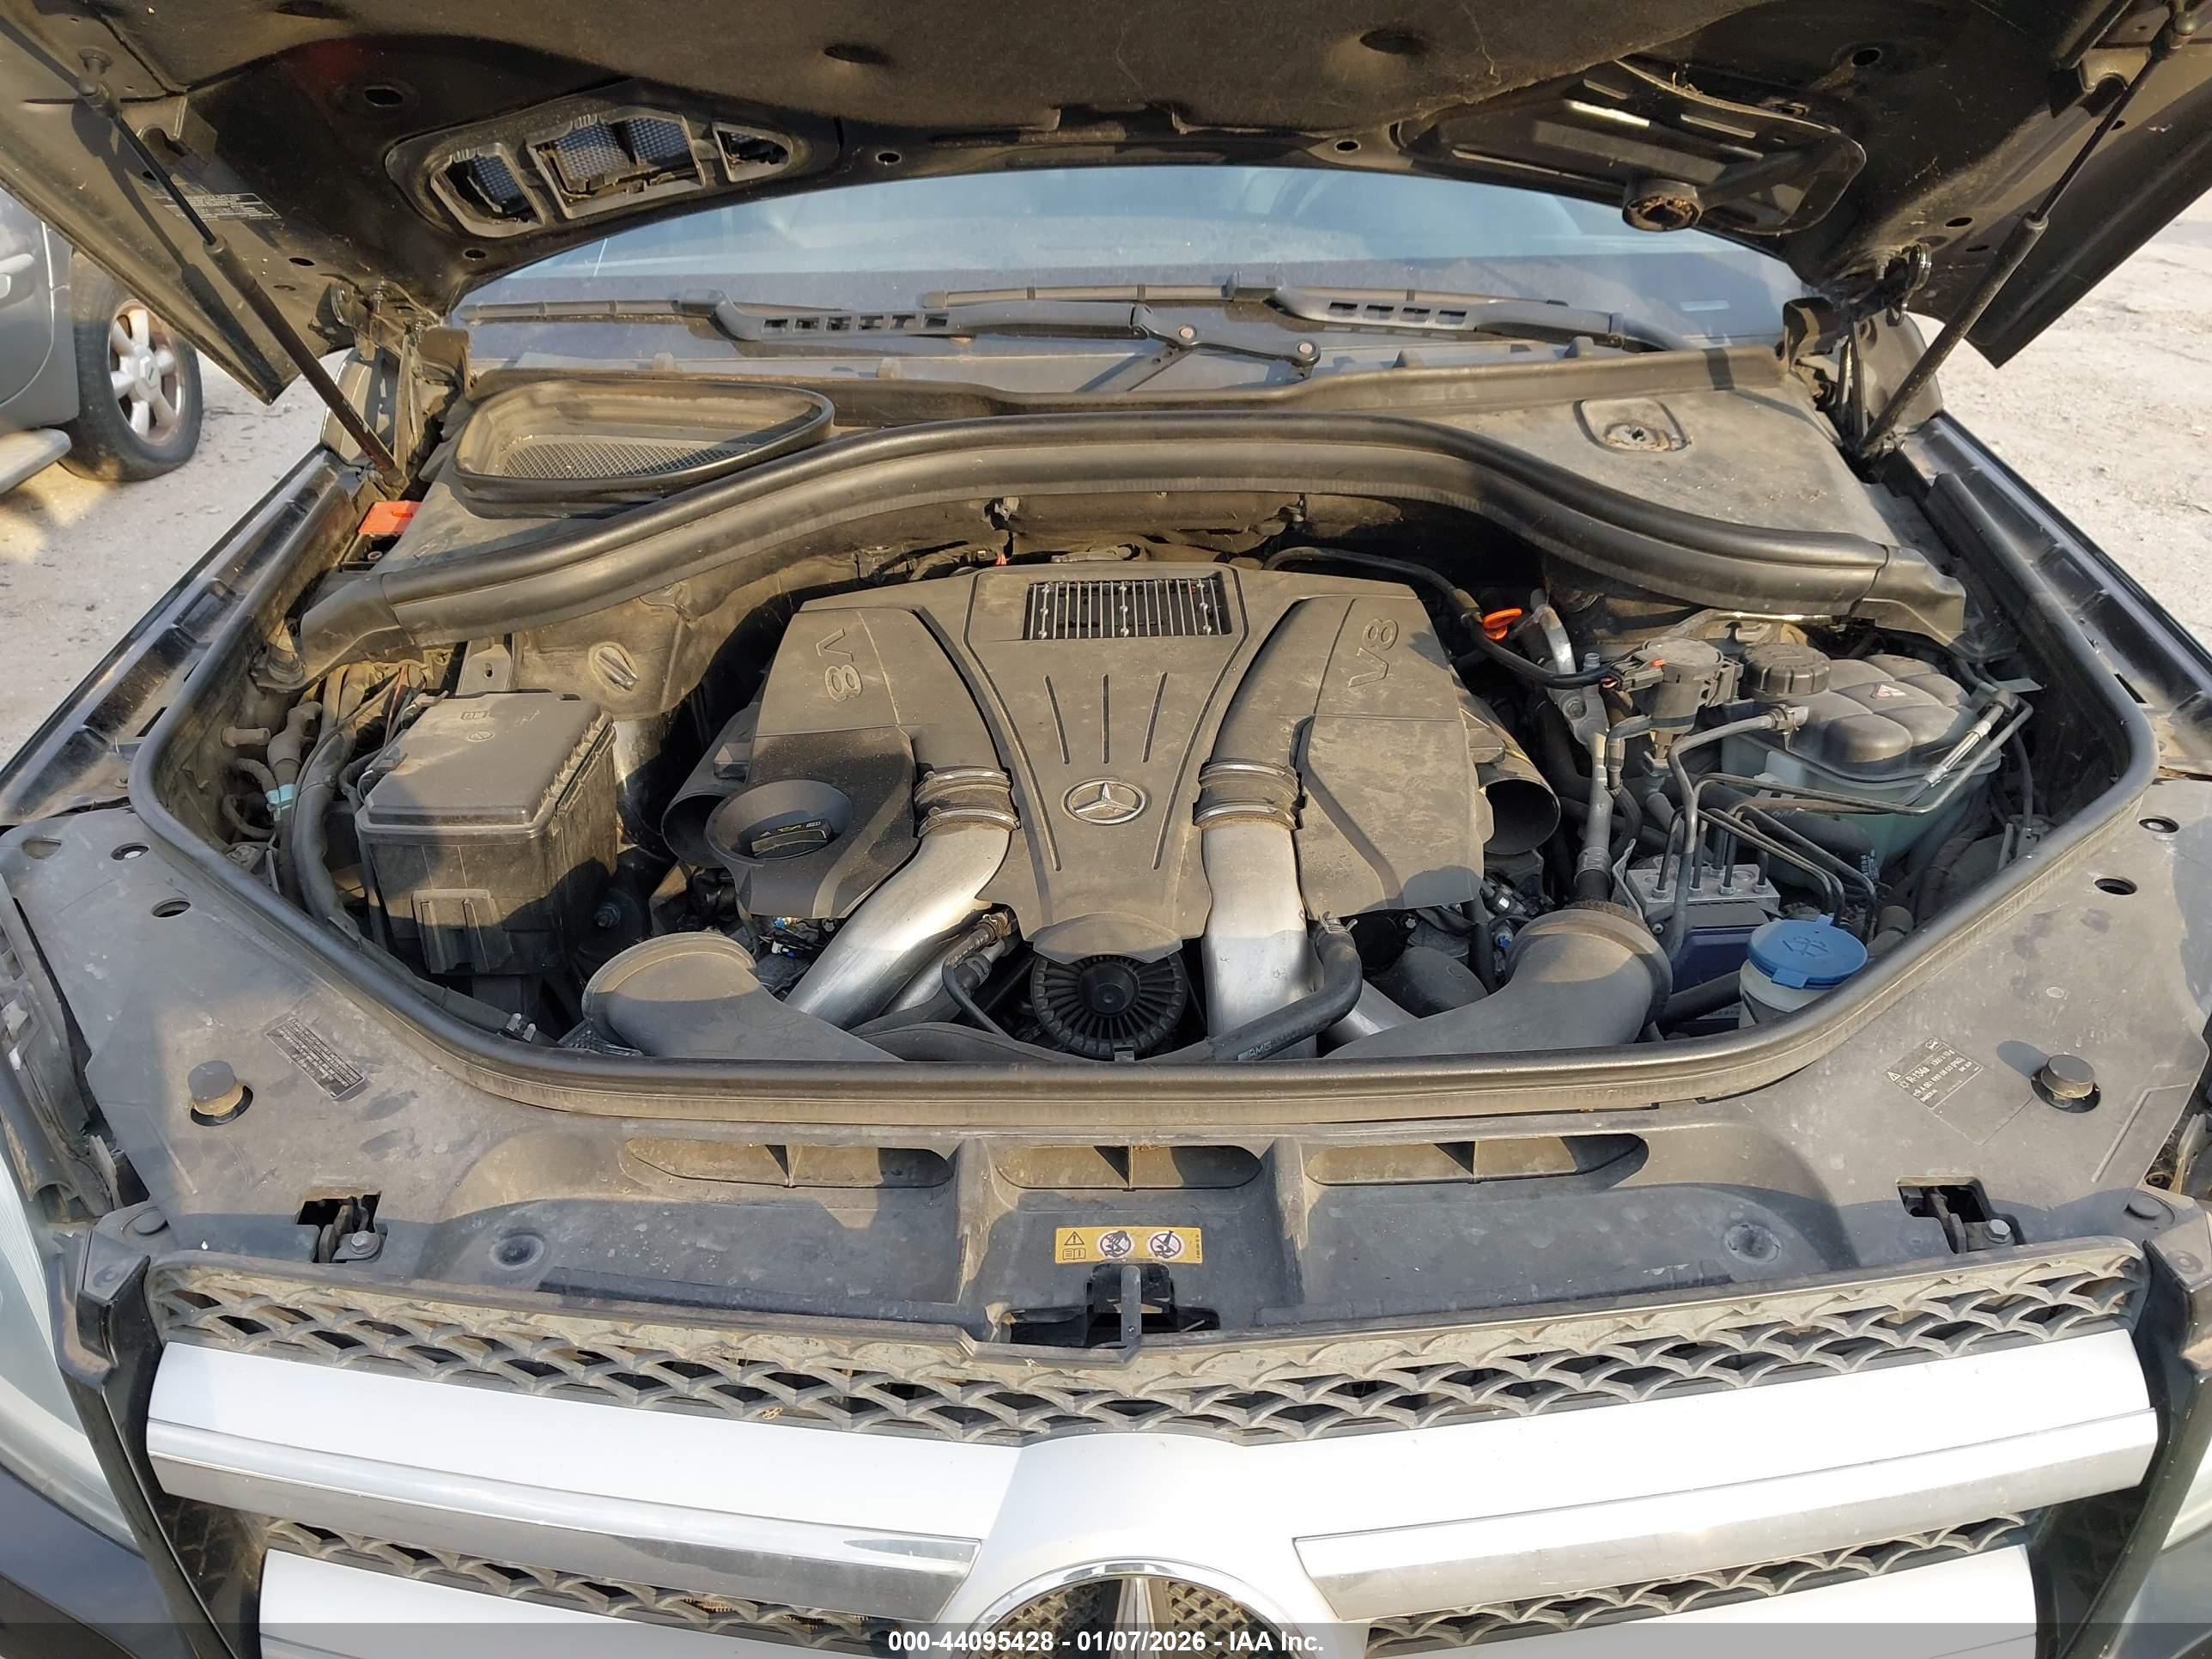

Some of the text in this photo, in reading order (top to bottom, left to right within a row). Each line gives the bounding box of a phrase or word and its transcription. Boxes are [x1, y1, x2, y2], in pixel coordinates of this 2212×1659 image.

[815, 627, 863, 702] V8
[1347, 618, 1399, 688] V8
[1248, 1040, 1272, 1058] AMG
[1905, 1066, 1930, 1084] R-134a
